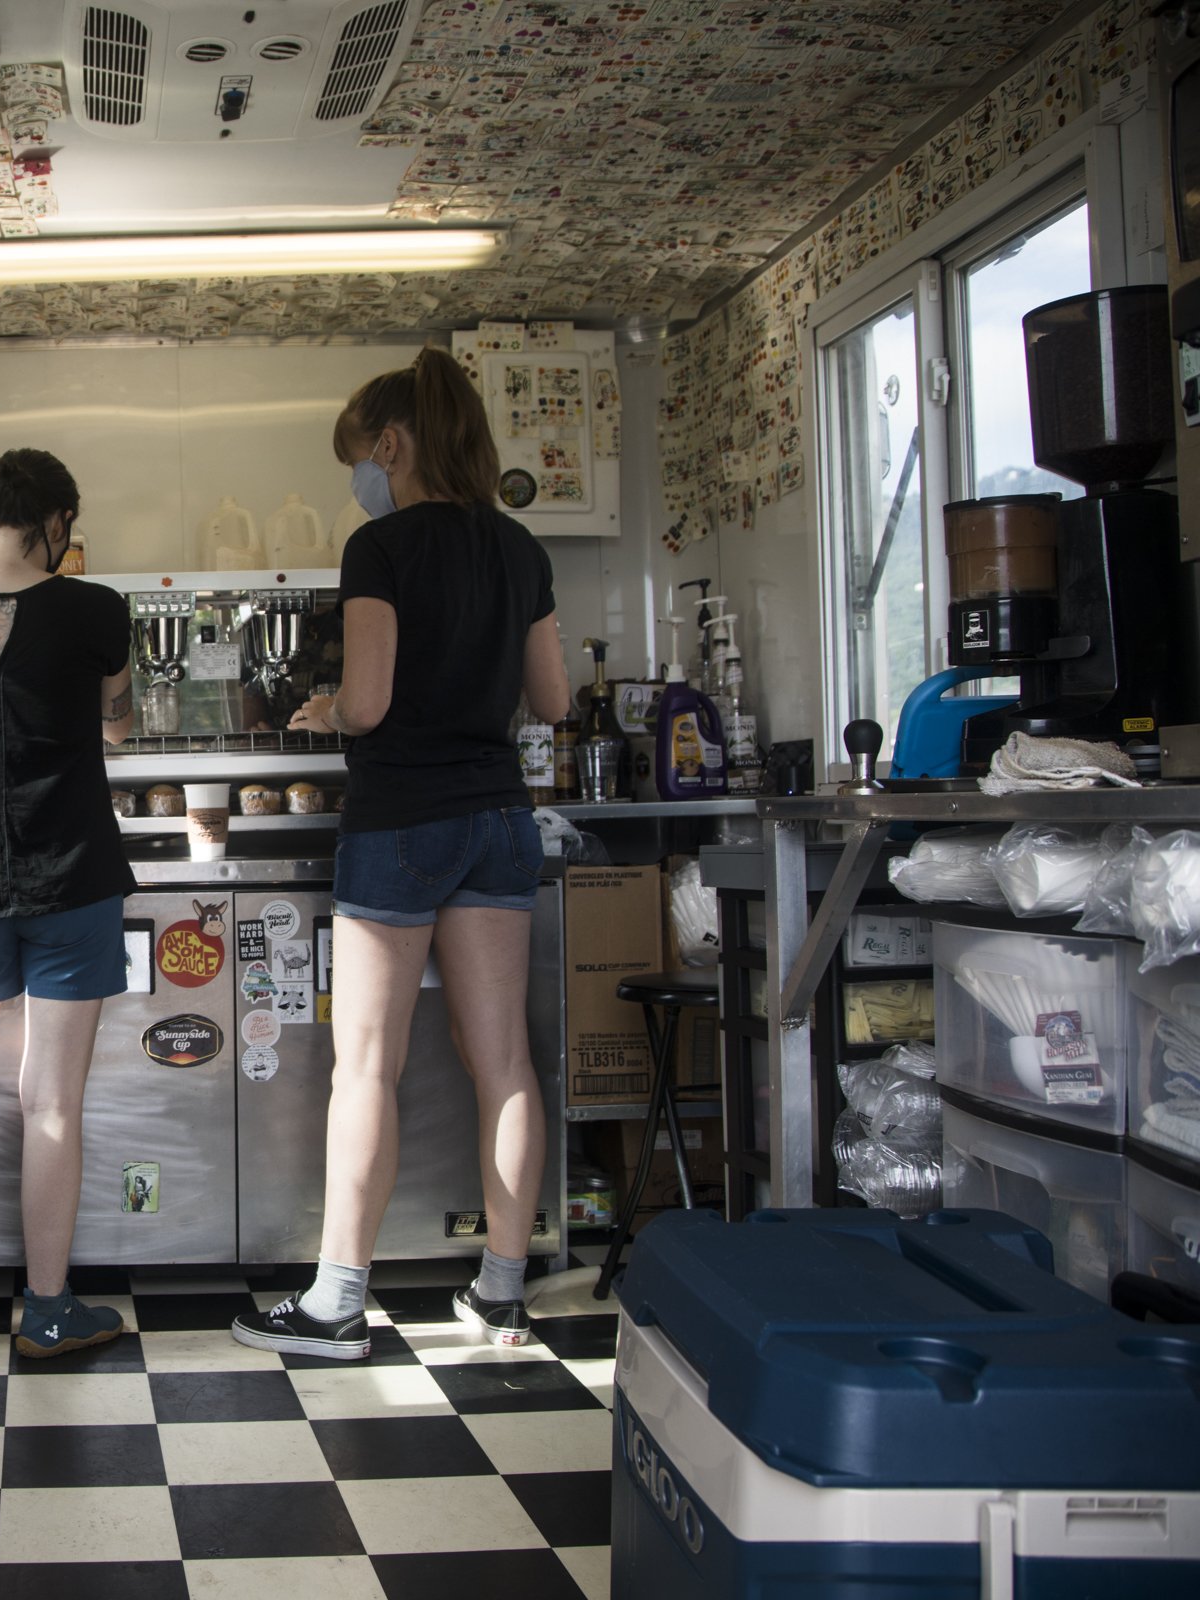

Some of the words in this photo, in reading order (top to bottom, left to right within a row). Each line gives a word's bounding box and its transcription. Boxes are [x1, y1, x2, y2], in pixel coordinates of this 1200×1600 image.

[61, 560, 83, 571] ONEY
[240, 923, 263, 931] WORK
[576, 964, 608, 973] SOLO
[155, 1029, 210, 1041] Sunnyside
[173, 1039, 191, 1052] Cup
[578, 1051, 625, 1067] TLB316
[627, 1415, 705, 1554] IGLOO
